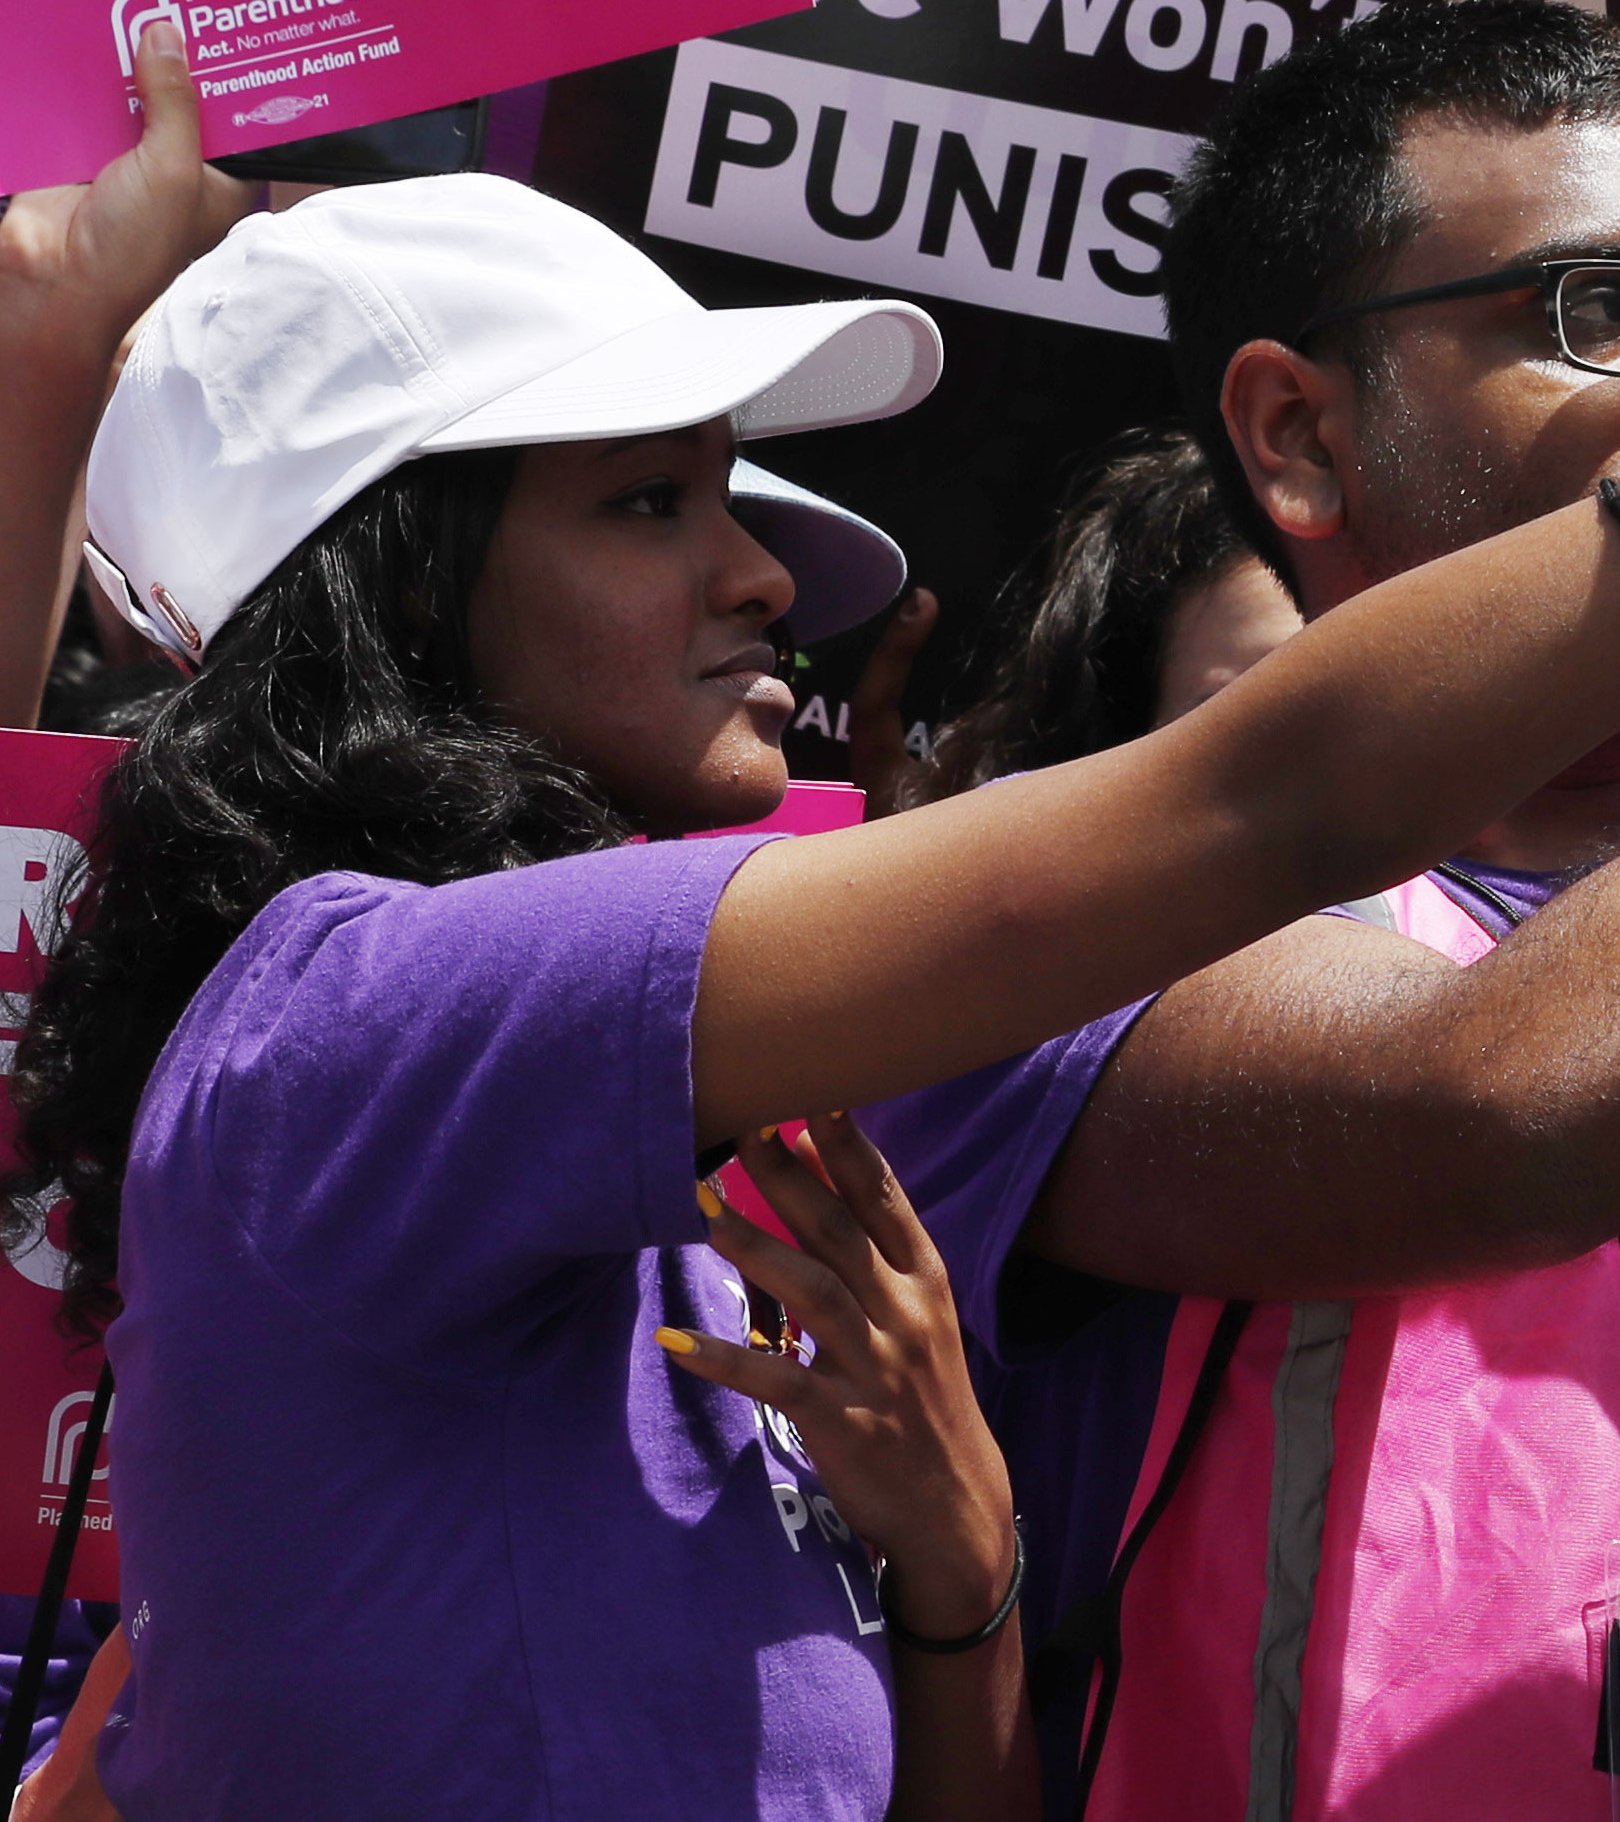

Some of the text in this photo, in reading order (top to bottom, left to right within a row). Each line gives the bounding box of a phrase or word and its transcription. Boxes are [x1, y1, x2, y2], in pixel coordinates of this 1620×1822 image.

[197, 9, 361, 60] Act. No matter what.
[200, 36, 401, 99] Parenthood Action Fund
[686, 81, 1168, 301] PUNIS
